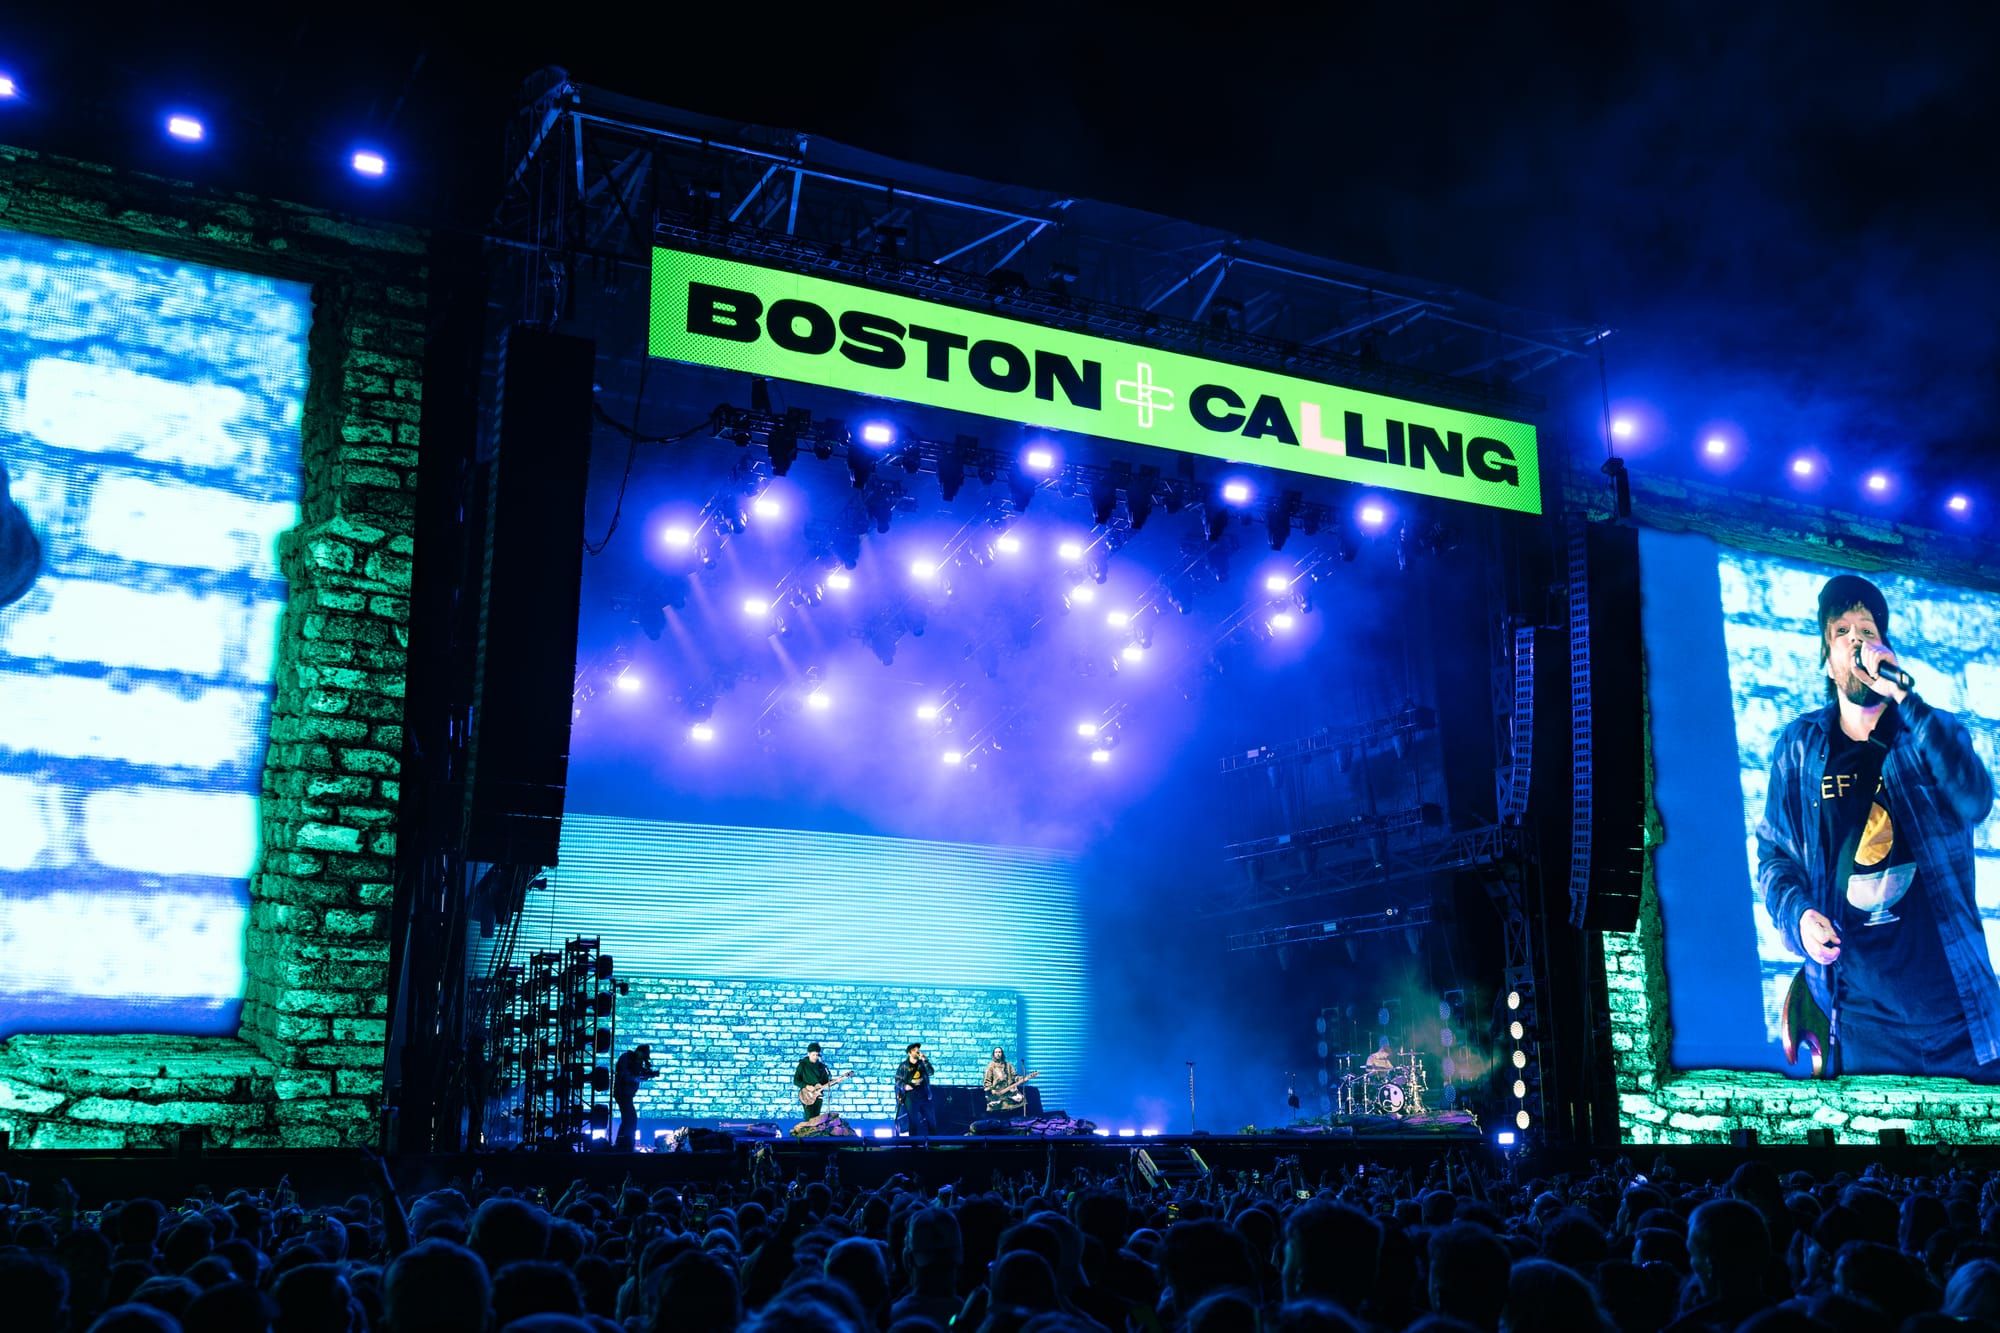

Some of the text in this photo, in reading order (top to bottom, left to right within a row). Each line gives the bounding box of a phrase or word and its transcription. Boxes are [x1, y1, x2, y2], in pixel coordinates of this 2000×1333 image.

[687, 281, 1520, 487] BOSTON CALLING
[1821, 773, 1858, 799] EF
